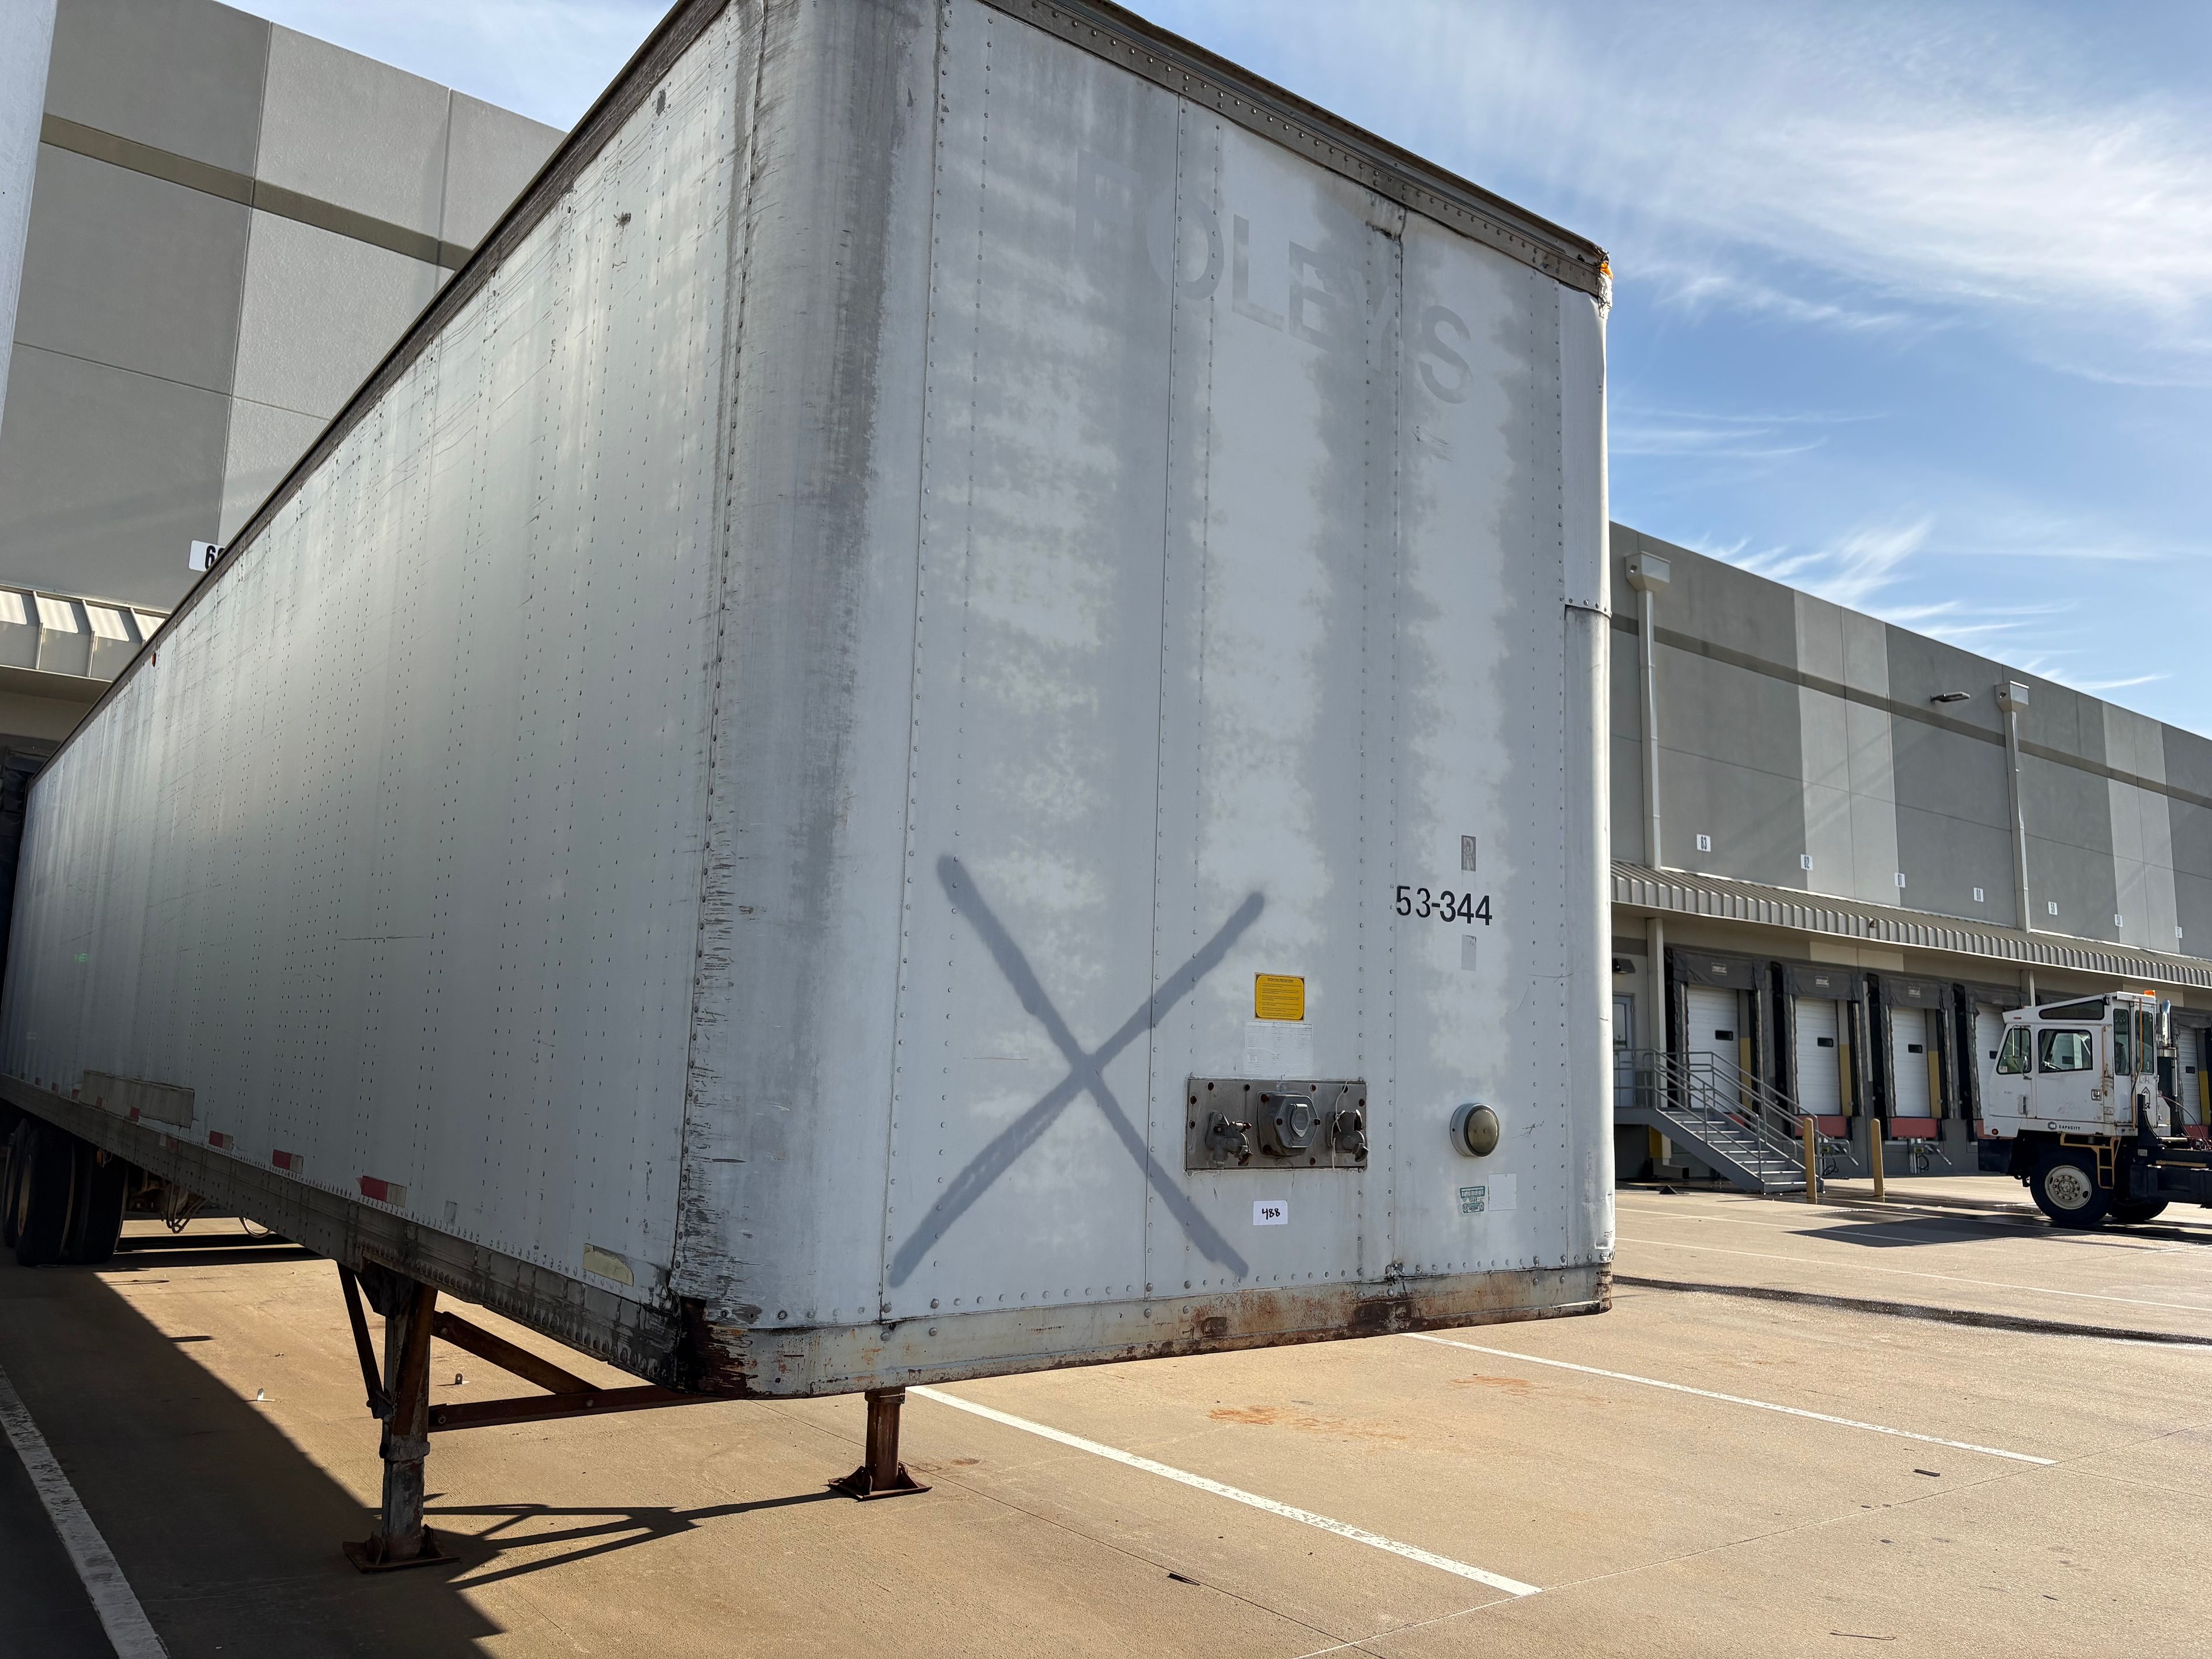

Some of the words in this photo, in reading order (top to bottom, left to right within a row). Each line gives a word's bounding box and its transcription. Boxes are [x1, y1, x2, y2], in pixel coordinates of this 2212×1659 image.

[1700, 836, 1707, 850] 63
[1463, 836, 1475, 870] R
[1804, 855, 1810, 869] 62
[1396, 885, 1493, 926] 53-344
[1262, 1207, 1281, 1220] 488
